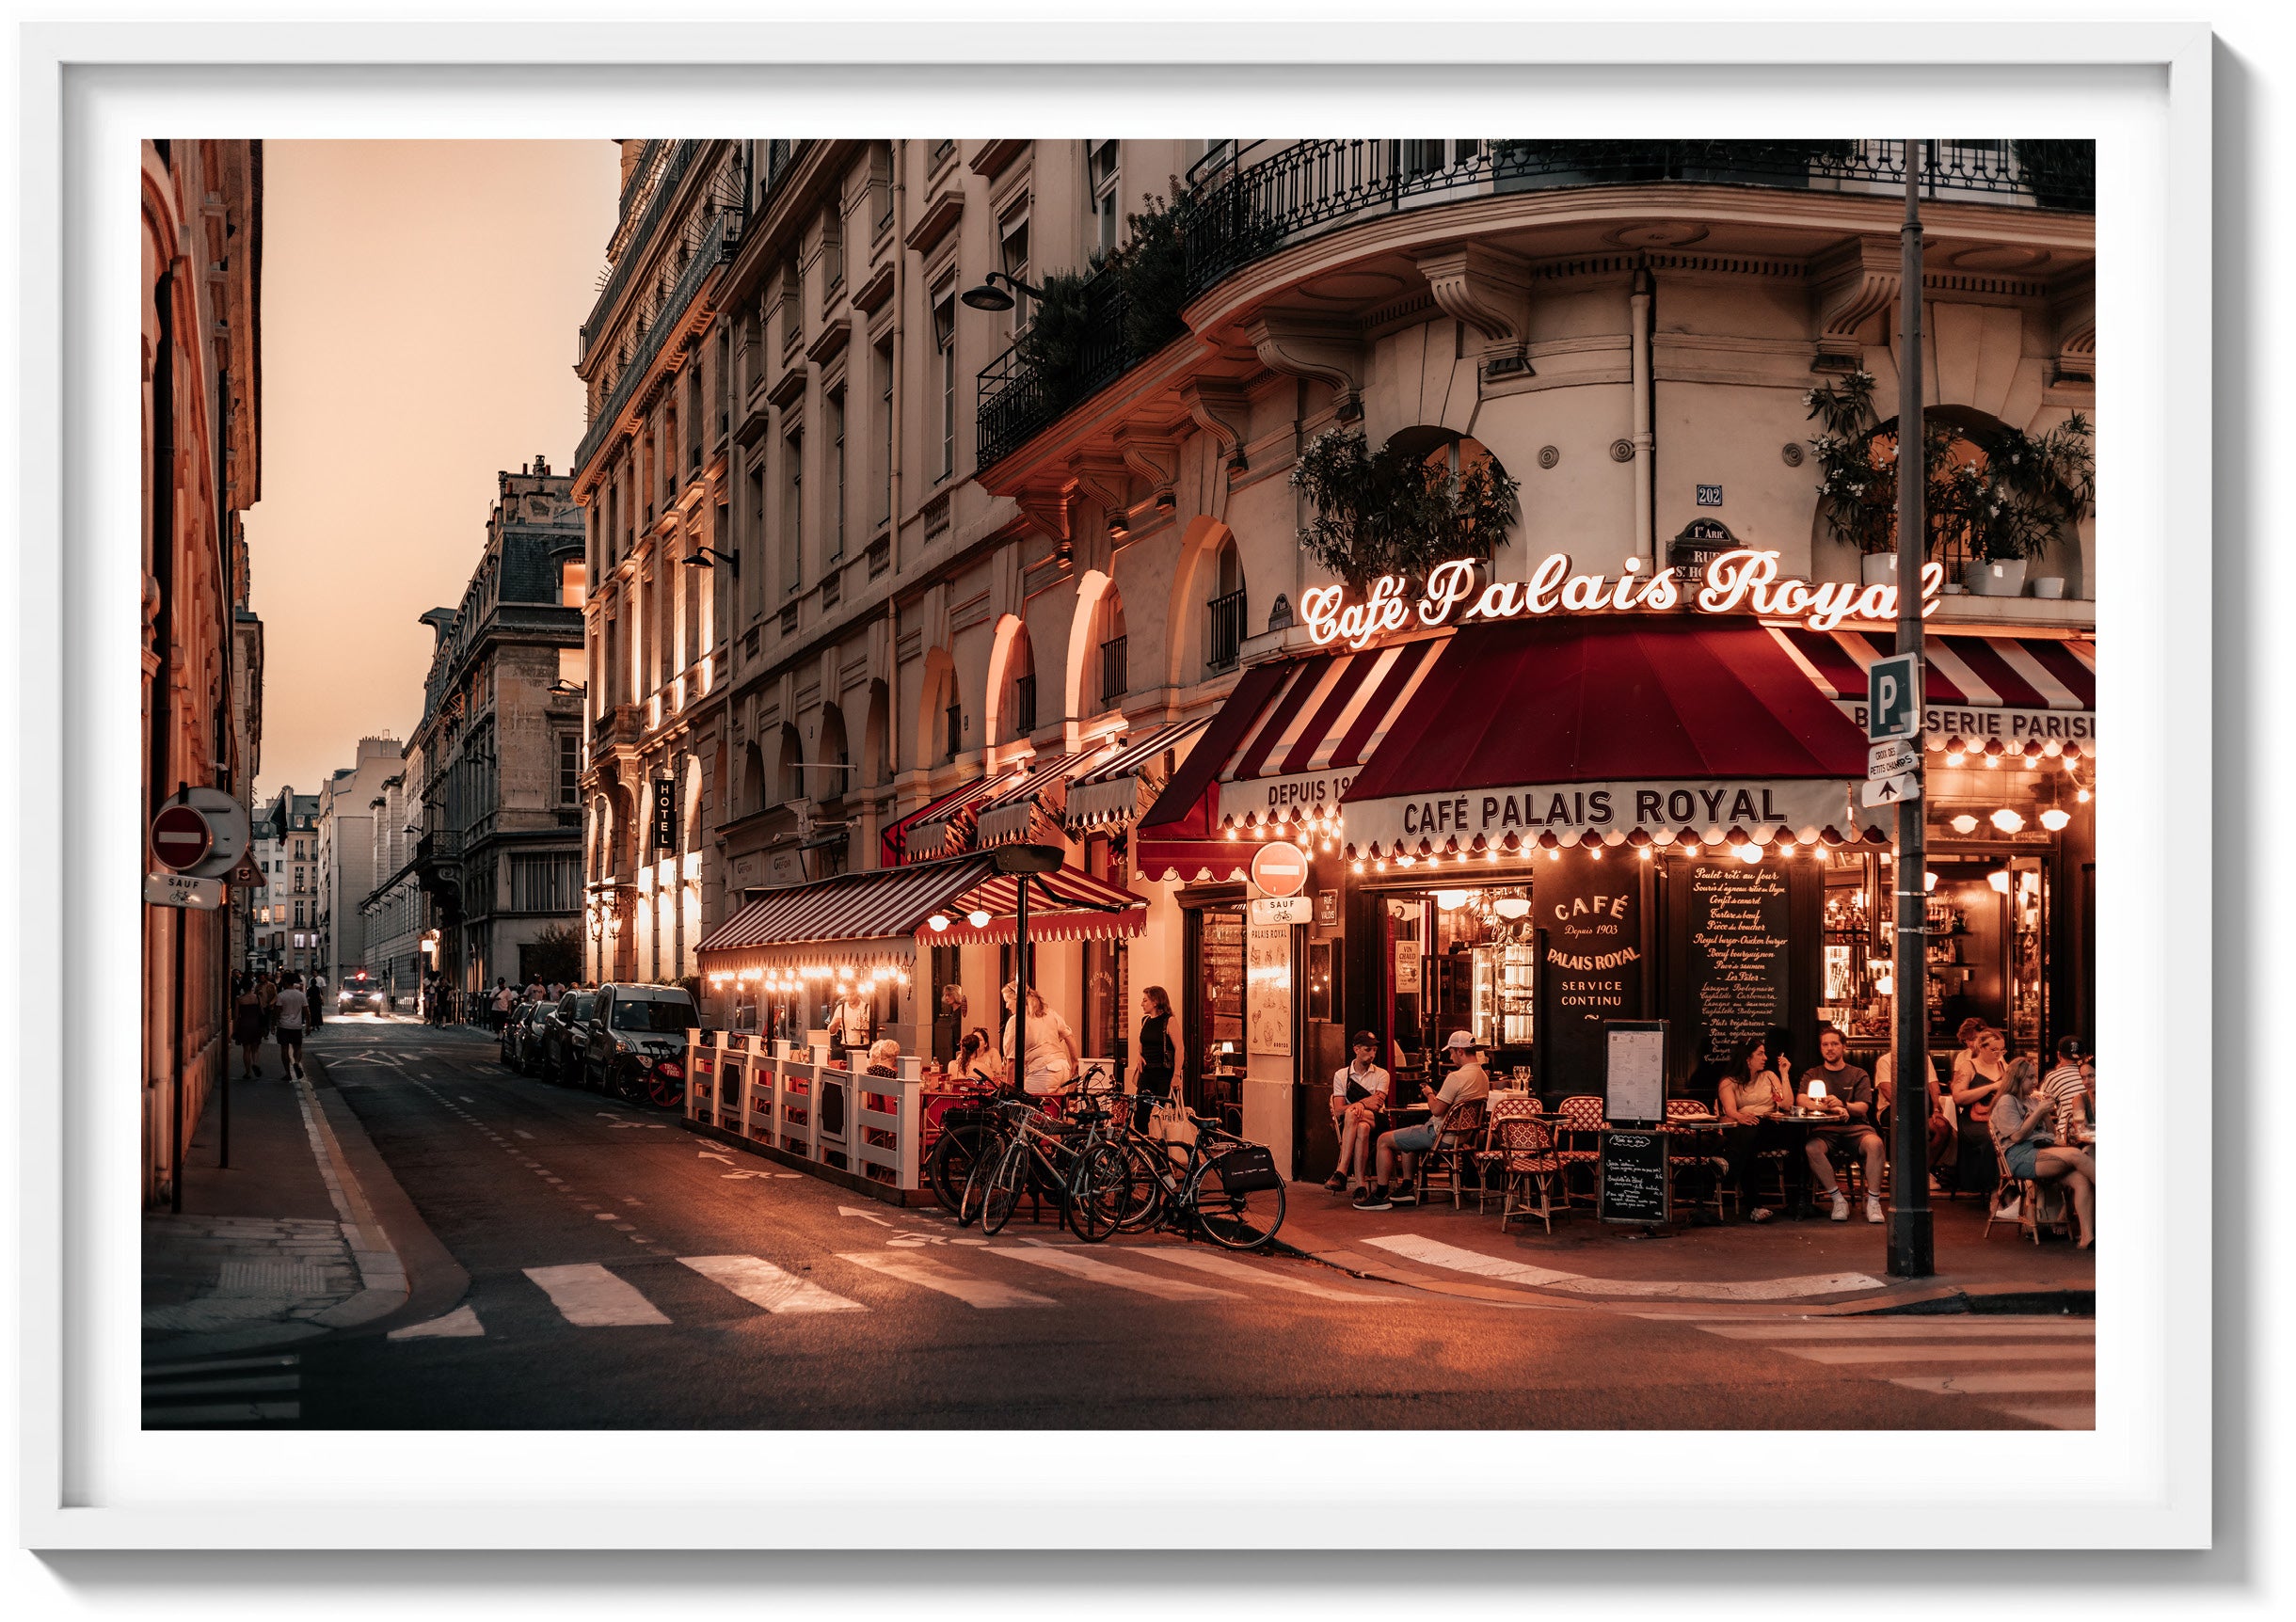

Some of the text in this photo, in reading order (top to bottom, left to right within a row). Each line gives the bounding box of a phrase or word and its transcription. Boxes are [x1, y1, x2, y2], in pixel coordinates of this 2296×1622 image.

[1699, 487, 1720, 503] 202
[1300, 549, 1944, 649] Café Palais Royal
[1879, 675, 1897, 724] P
[1854, 707, 2002, 736] BSERIE
[1875, 747, 1896, 760] CROIX DES
[1870, 755, 1913, 775] PETITS CHAMPS
[1268, 776, 1357, 806] DEPUIS 19
[660, 785, 670, 844] HOTEL
[1404, 788, 1787, 835] CAFÉ PALAIS ROYAL
[168, 878, 199, 889] SAUF
[1695, 867, 1722, 879] Poulet
[1755, 868, 1778, 884] four
[1269, 900, 1295, 909] SAUF
[1555, 895, 1629, 921] CAFÉ
[1710, 895, 1731, 909] Confit
[1252, 929, 1287, 939] PALAIS ROYAL
[1564, 924, 1618, 939] Depuis 1903
[1693, 933, 1718, 947] Royal
[1547, 946, 1641, 971] PALAIS ROYAL
[1562, 981, 1622, 991] SERVICE
[1561, 996, 1621, 1006] CONTINU
